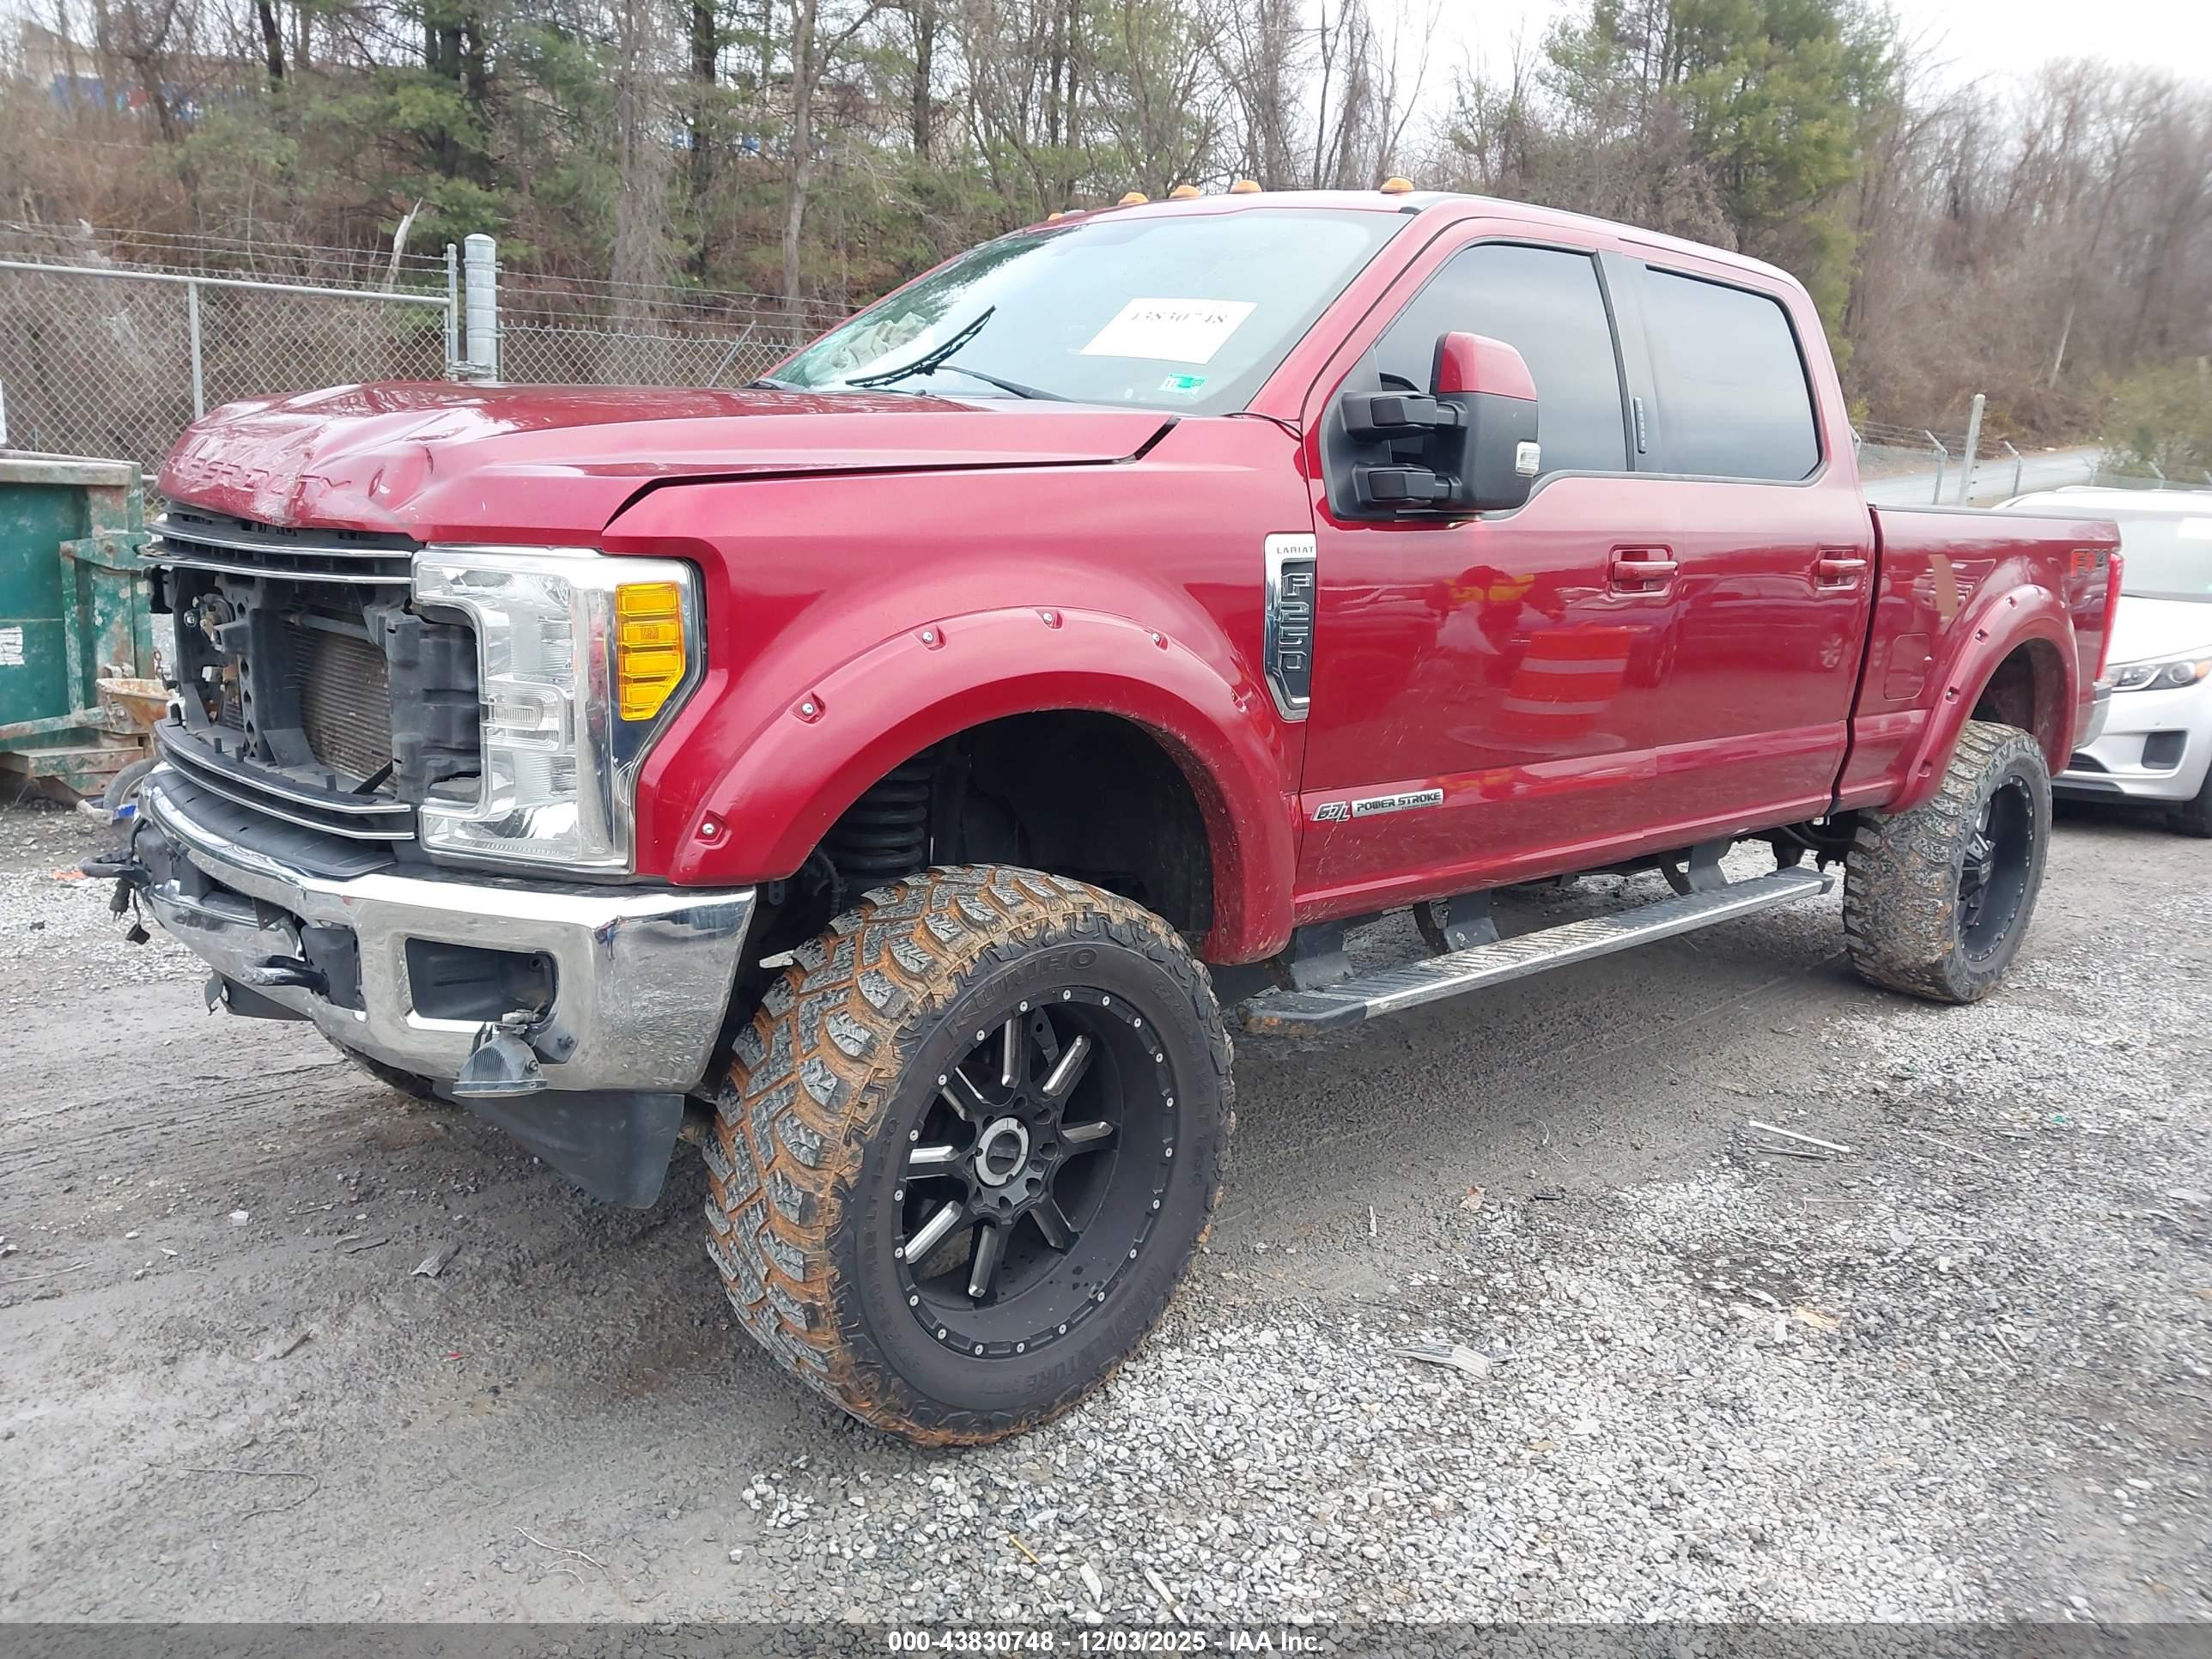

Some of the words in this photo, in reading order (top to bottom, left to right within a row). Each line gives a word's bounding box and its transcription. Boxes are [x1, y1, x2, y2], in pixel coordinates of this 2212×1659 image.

[1276, 546, 1315, 555] LARIAT
[1356, 798, 1396, 812] POWER
[1397, 791, 1443, 806] STROKE
